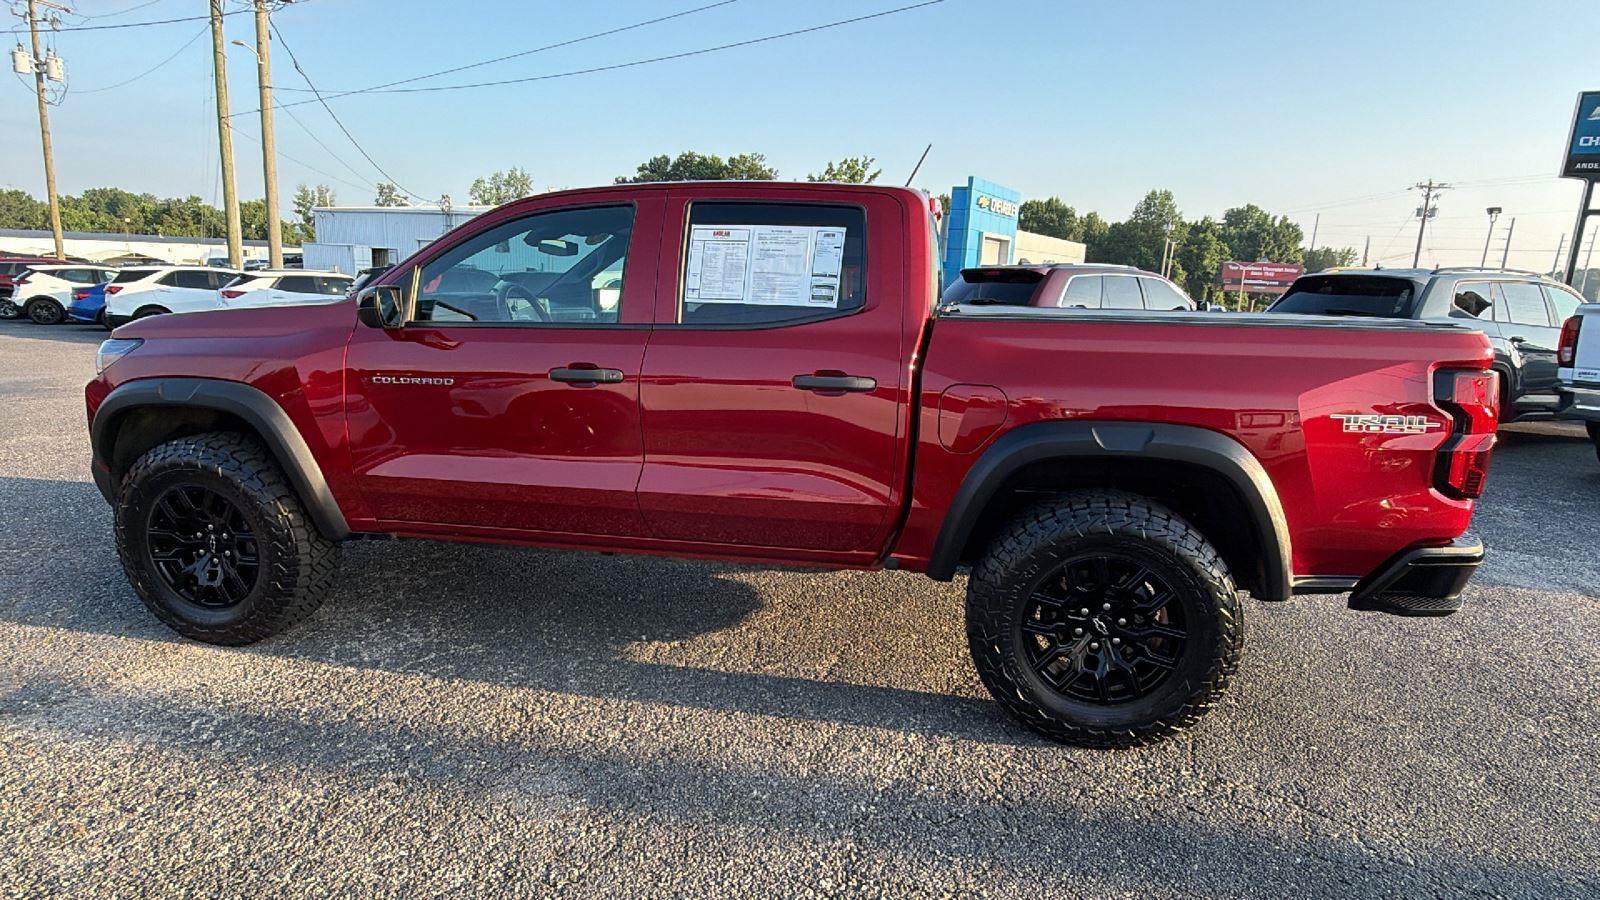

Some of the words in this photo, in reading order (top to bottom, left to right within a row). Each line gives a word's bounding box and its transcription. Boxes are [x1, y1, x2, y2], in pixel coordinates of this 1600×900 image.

[1579, 136, 1600, 146] CH
[372, 376, 454, 385] COLORADO
[1330, 414, 1440, 427] TRAIL
[1343, 424, 1427, 434] BOSS
